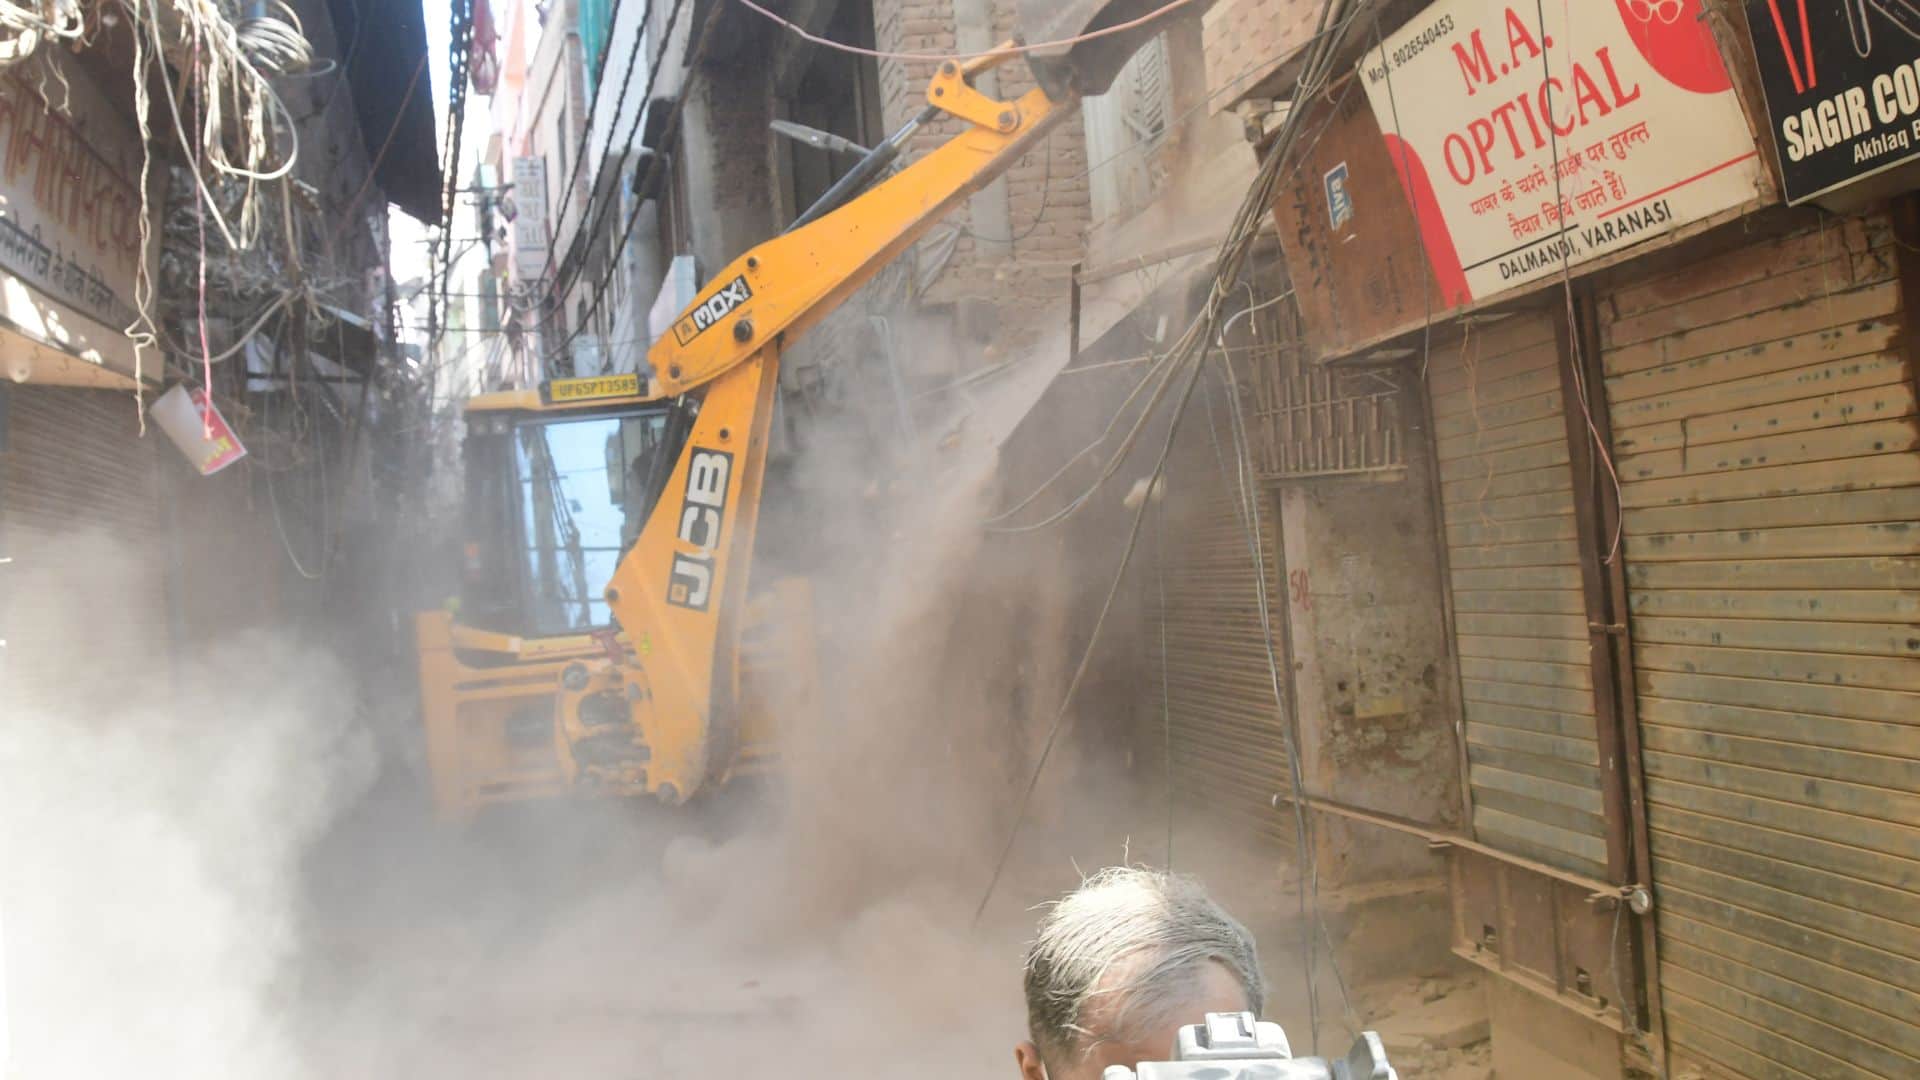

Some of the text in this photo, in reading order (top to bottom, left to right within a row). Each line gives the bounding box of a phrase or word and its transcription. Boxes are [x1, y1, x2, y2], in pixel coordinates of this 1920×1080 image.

[1451, 7, 1554, 95] M.A.
[1443, 46, 1641, 186] OPTICAL
[1783, 86, 1872, 162] SAGIR
[1854, 129, 1909, 165] Akhlaq
[1470, 193, 1499, 215] पावर
[1500, 179, 1515, 201] के
[1586, 141, 1607, 161] पर
[1507, 213, 1542, 240] तैयार
[1575, 180, 1607, 210] जाते
[1500, 200, 1672, 280] DALMANDI, VARANASI
[675, 452, 728, 606] JCB
